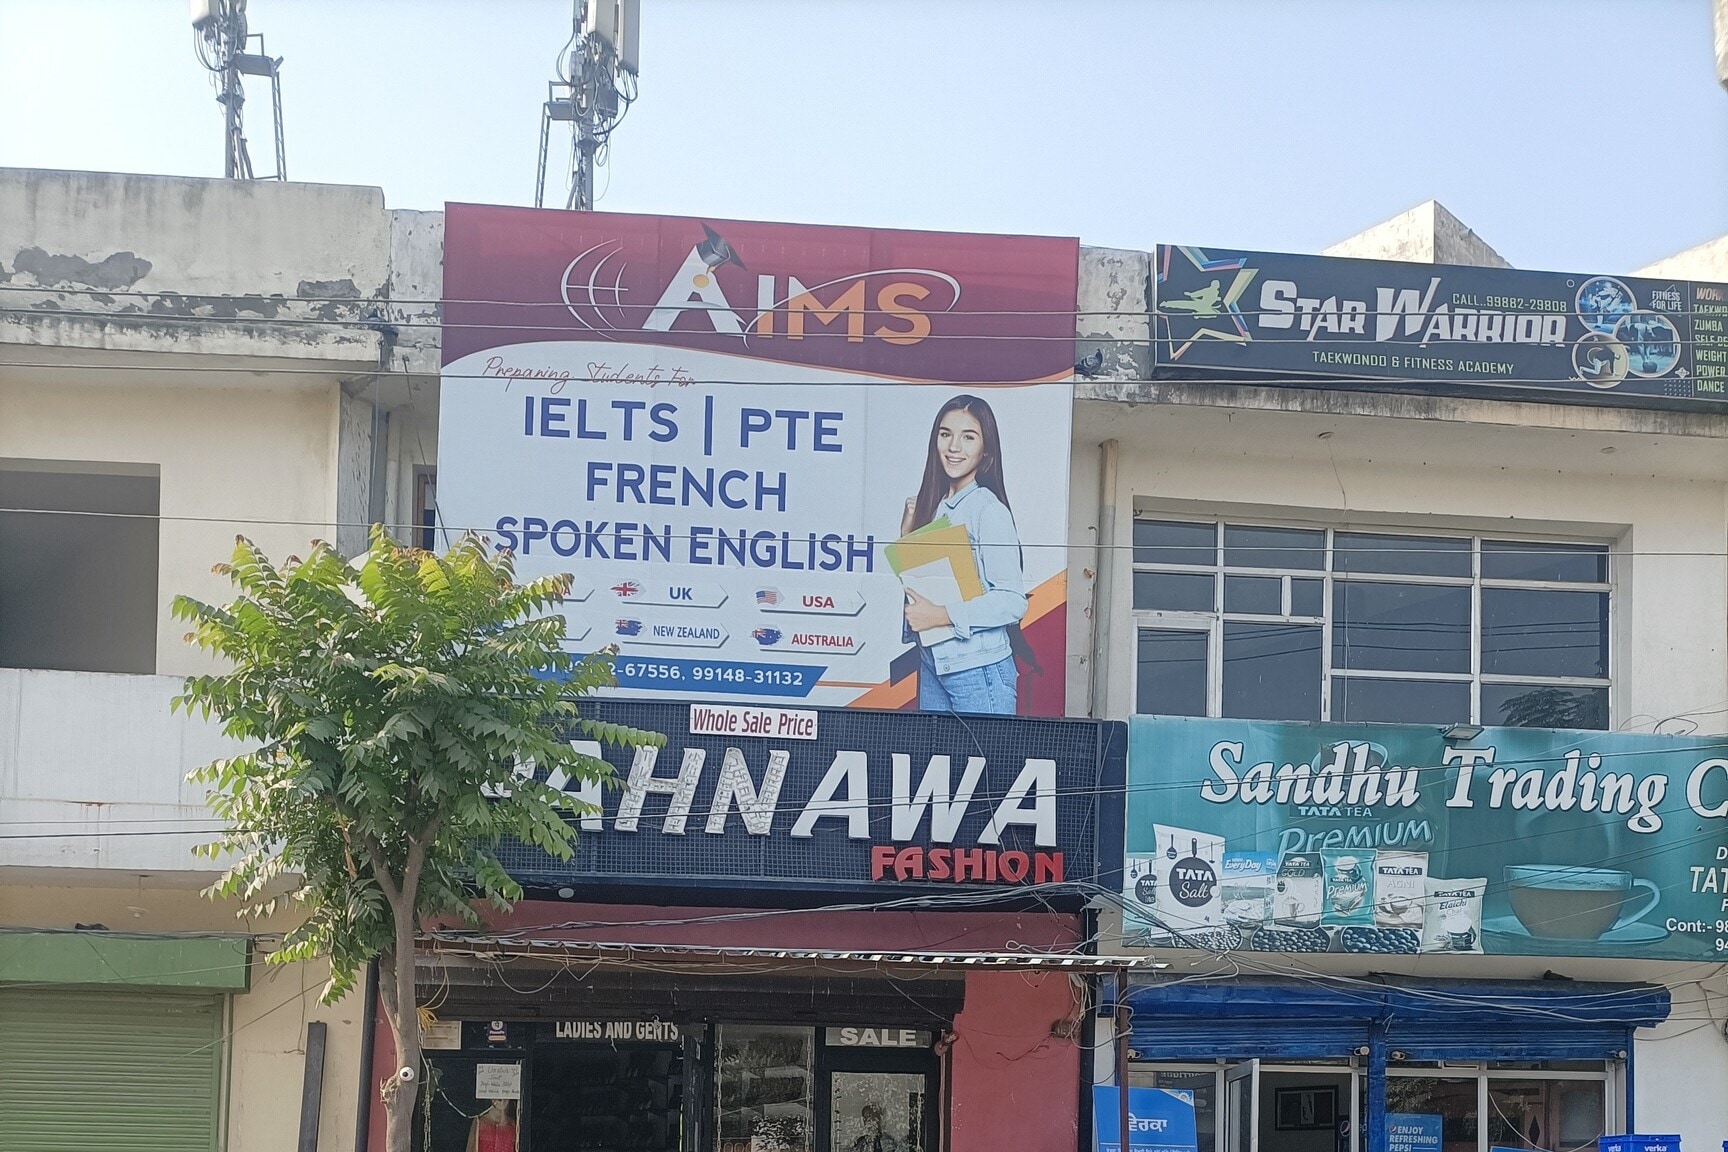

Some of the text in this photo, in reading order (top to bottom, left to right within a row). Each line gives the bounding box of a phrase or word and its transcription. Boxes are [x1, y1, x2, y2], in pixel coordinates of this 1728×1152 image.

[641, 243, 932, 345] AIMS
[1694, 319, 1724, 332] ZUMBA
[1312, 351, 1387, 367] TAEKWONDO
[1404, 357, 1454, 371] FITNESS
[1458, 361, 1514, 374] ACADEMY
[1697, 365, 1726, 378] POWER
[1697, 380, 1725, 393] DANCE
[524, 396, 679, 442] IELTS
[740, 407, 844, 453] PTE
[586, 461, 787, 512] FRENCH
[494, 516, 874, 573] SPOKEN ENGLISH
[669, 586, 694, 600] UK
[802, 595, 835, 609] USA
[653, 625, 720, 640] NEW ZEALAND
[791, 633, 855, 648] AUSTRALIA
[692, 667, 803, 686] 99148-31132
[693, 708, 814, 737] Whole Sale Price
[483, 739, 1058, 847] AHNAWA
[1199, 741, 1421, 808] Sandhu
[1442, 745, 1668, 834] Trading
[1298, 806, 1373, 817] TATA TEA
[871, 845, 1064, 884] FASHION
[1176, 868, 1214, 882] TATA
[1179, 881, 1209, 899] Salt
[556, 1021, 602, 1039] LADIES
[605, 1022, 632, 1040] AND
[840, 1027, 917, 1046] SALE
[1389, 1134, 1439, 1145] REFRESHING
[1397, 1125, 1424, 1136] ENJOY
[1389, 1143, 1412, 1152] PEPSI
